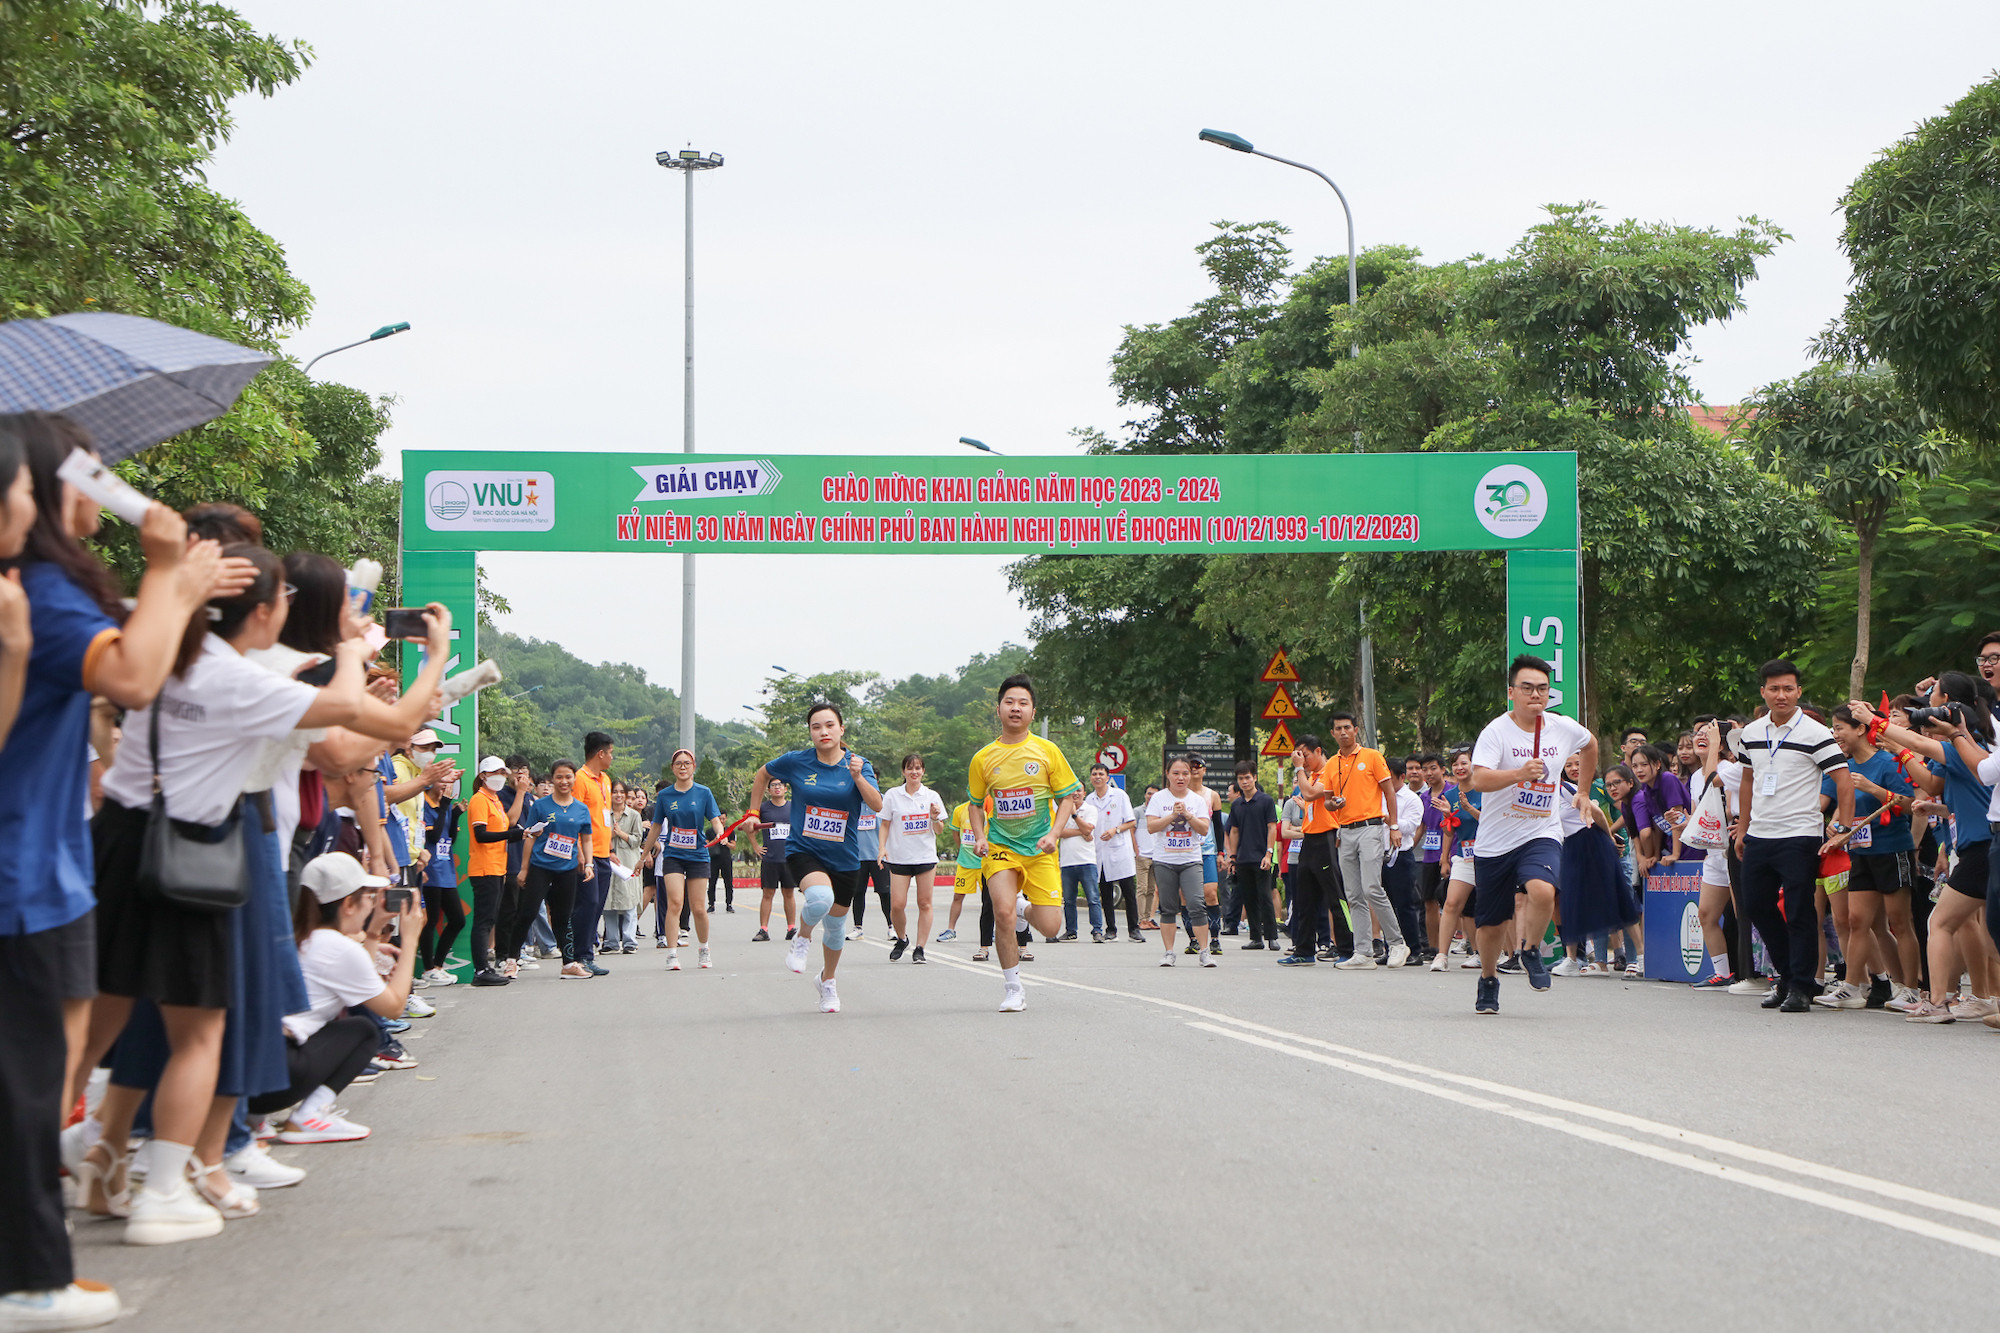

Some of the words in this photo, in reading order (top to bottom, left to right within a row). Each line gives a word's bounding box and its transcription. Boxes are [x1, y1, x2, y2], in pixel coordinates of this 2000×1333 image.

[656, 467, 697, 493] GIẢI
[705, 469, 758, 494] CHẠY
[822, 472, 869, 502] CHÀO
[874, 472, 927, 502] MỪNG
[932, 477, 972, 502] KHAI
[977, 470, 1029, 502] GIẢNG
[1035, 473, 1075, 502] NĂM
[1080, 477, 1115, 507] HỌC
[1119, 477, 1162, 502] 2023
[1178, 477, 1221, 502] 2024
[473, 483, 522, 506] VNU
[617, 507, 641, 541] KỶ
[645, 510, 692, 547] NIỆM
[696, 516, 718, 541] 30
[723, 511, 764, 541] NĂM
[769, 511, 816, 542] NGÀY
[821, 512, 875, 542] CHÍNH
[879, 509, 915, 542] PHỦ
[919, 517, 956, 542] BAN
[960, 512, 1008, 542] HÀNH
[1013, 517, 1054, 547] NGHỊ
[1059, 517, 1101, 547] ĐỊNH
[1105, 509, 1127, 542] VỀ
[1131, 516, 1201, 545] ĐHQGHN
[1206, 515, 1308, 545] (10/12/1993
[998, 798, 1031, 811] 30.240
[1518, 791, 1552, 808] 30.217
[808, 817, 842, 833] 30.235
[904, 821, 927, 830] 30.238
[955, 877, 965, 887] 29
